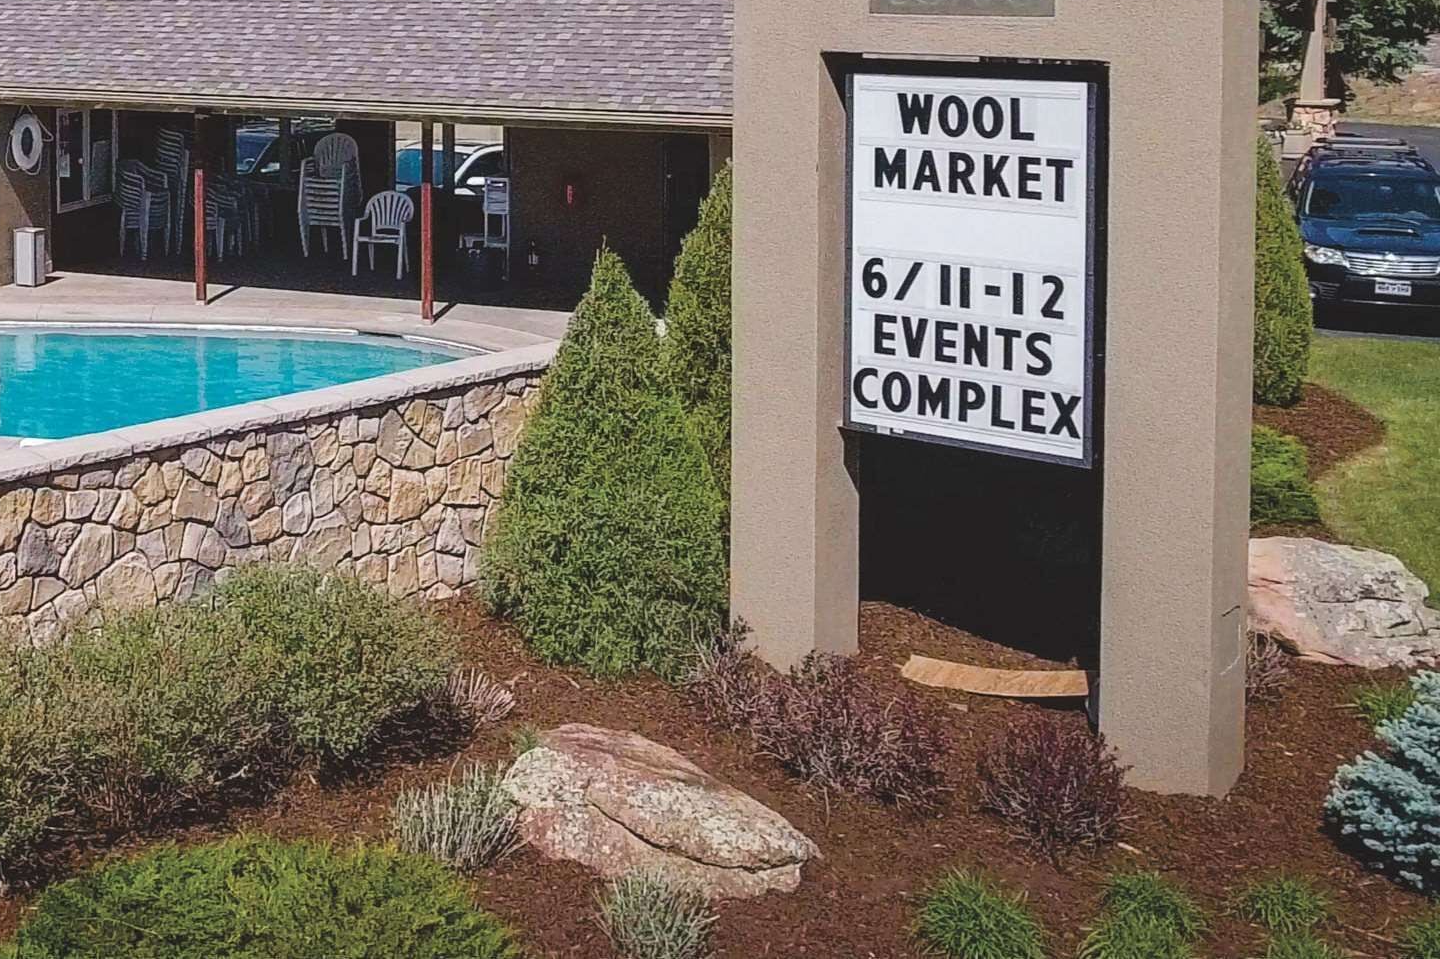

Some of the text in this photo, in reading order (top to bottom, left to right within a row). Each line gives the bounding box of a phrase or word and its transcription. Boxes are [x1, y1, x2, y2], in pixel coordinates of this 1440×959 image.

[896, 92, 1036, 142] WOOL
[873, 147, 1074, 203] MARKET
[861, 257, 1065, 320] 6/11-12
[873, 313, 1053, 376] EVENTS
[852, 367, 1081, 439] COMPLEX
